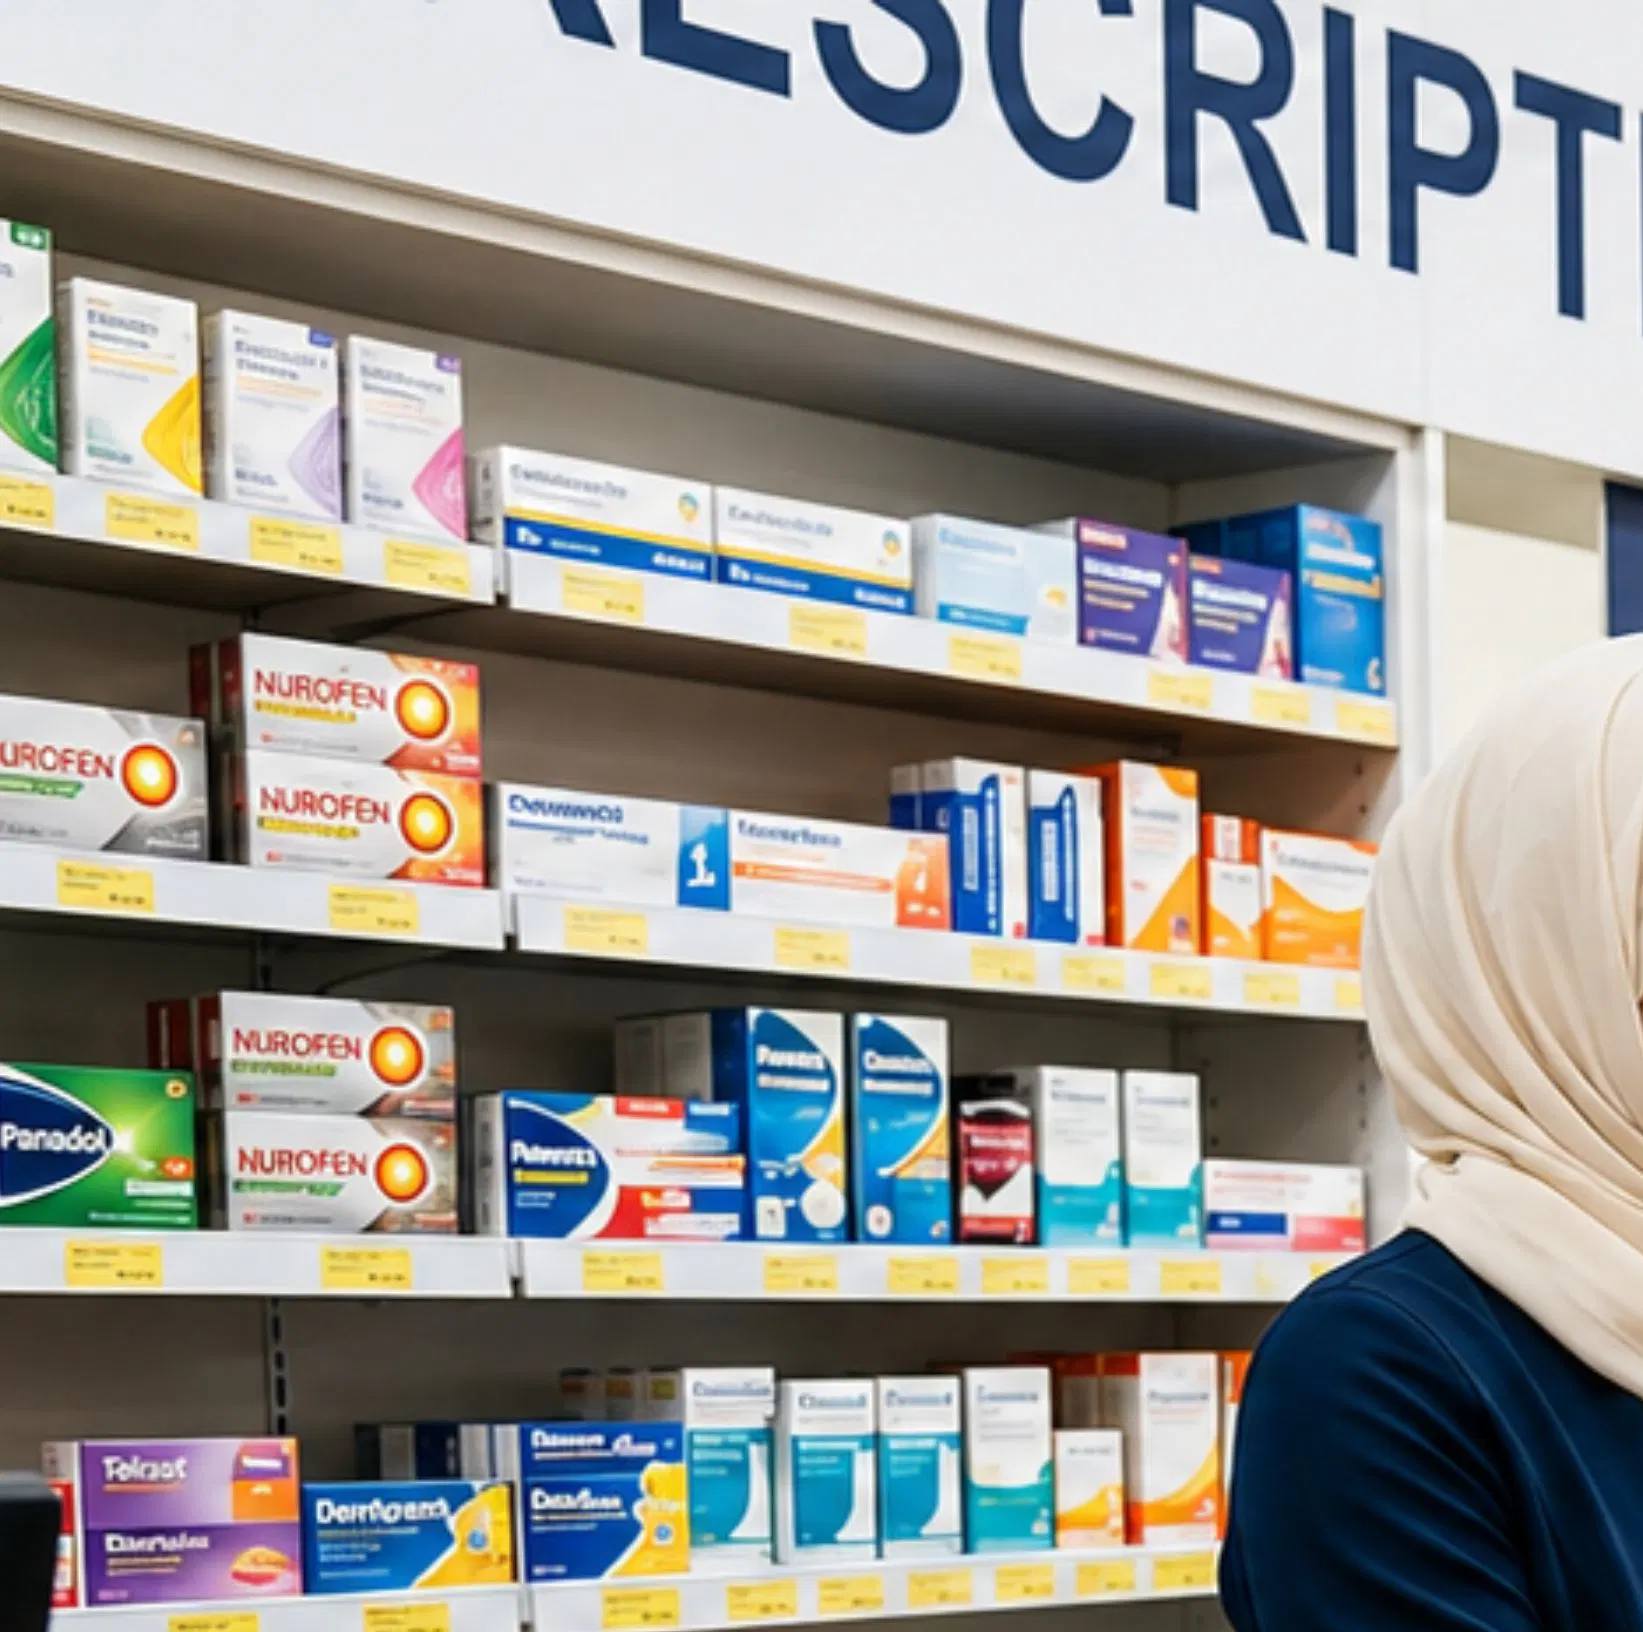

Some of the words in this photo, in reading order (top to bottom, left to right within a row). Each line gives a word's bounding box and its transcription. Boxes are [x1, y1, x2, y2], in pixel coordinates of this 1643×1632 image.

[253, 668, 388, 712] NUROFEN
[259, 785, 391, 825] NUROFEN
[232, 1027, 362, 1061] NUROFEN
[237, 1146, 367, 1176] NUROFEN
